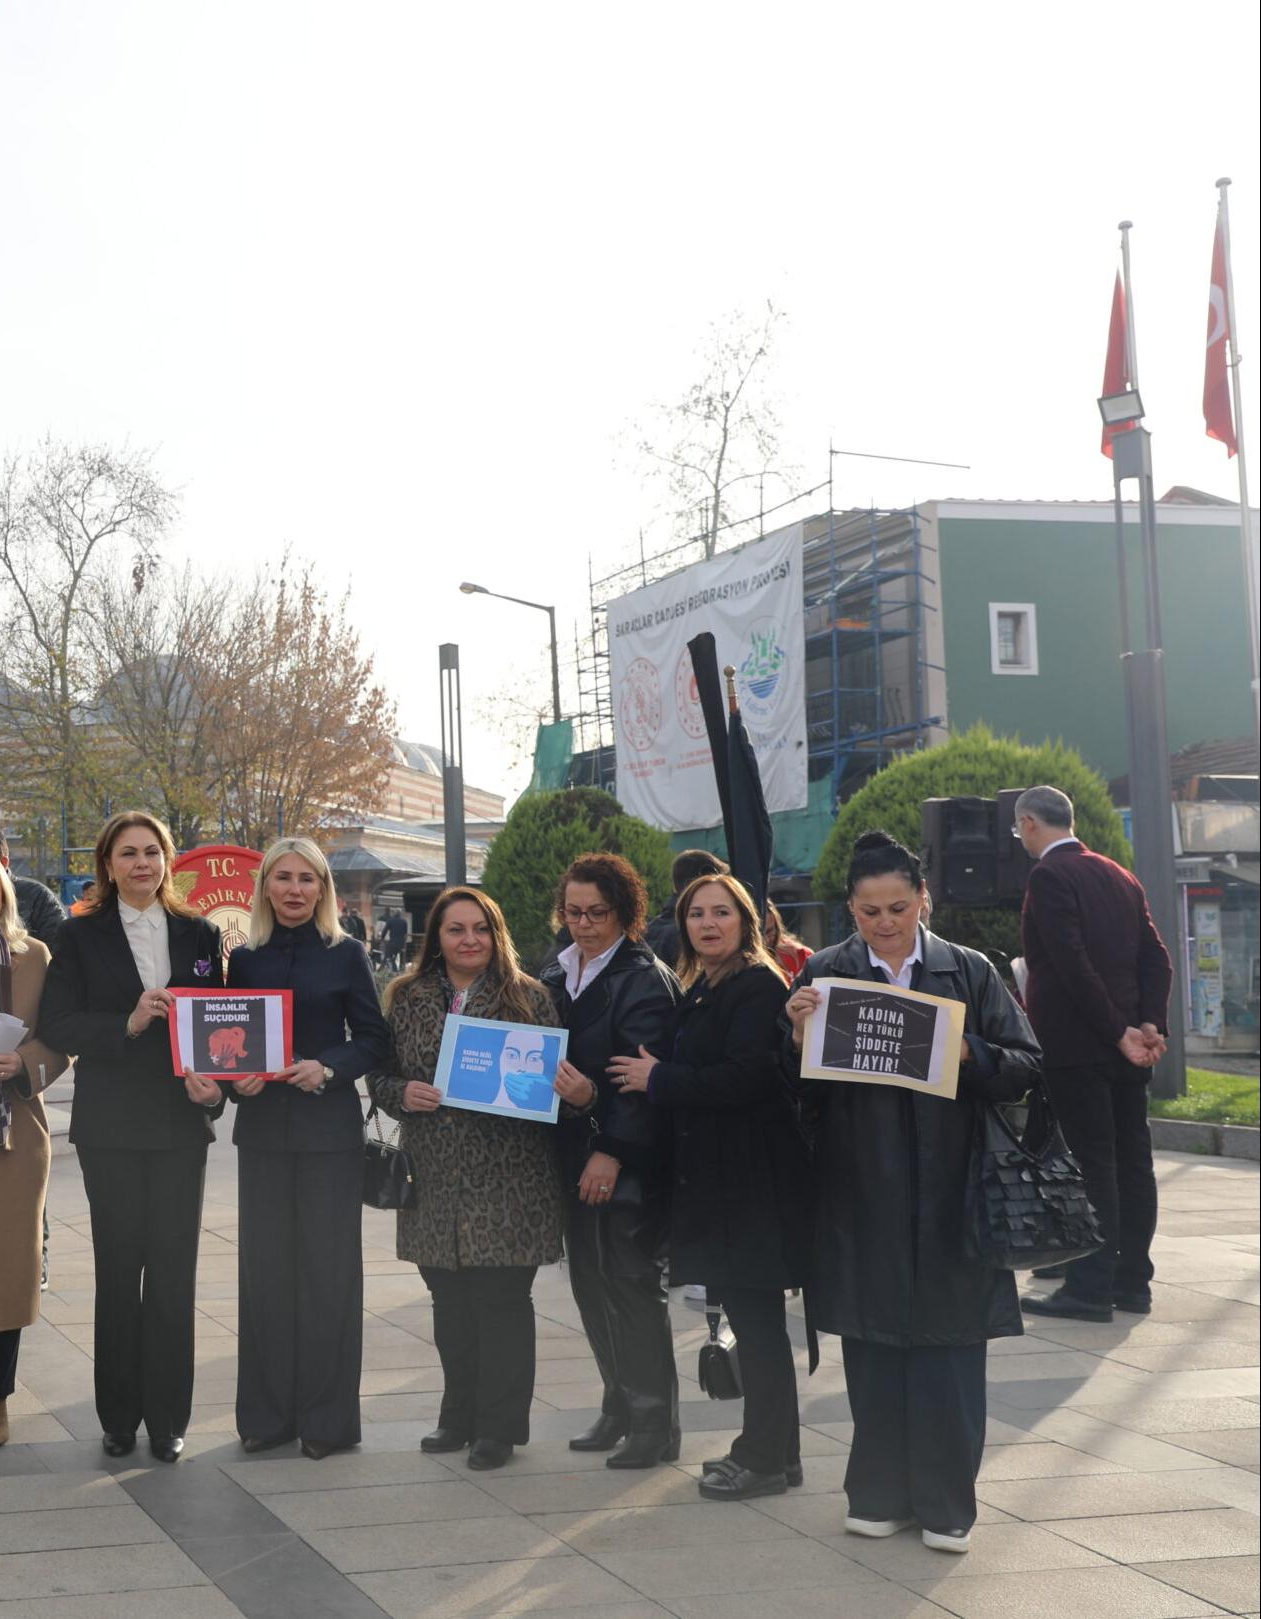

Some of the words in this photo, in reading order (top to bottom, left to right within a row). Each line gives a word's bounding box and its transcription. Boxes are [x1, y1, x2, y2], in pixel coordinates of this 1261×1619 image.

[206, 857, 240, 877] T.C.
[205, 1002, 247, 1011] İNSANLIK
[858, 1006, 904, 1026] KADINA
[204, 1014, 250, 1023] SUÇUDUR!
[856, 1023, 873, 1032] HER
[877, 1024, 903, 1038] TÜRLÜ
[855, 1034, 901, 1055] ŞİDDETE
[852, 1054, 899, 1073] HAYIR!
